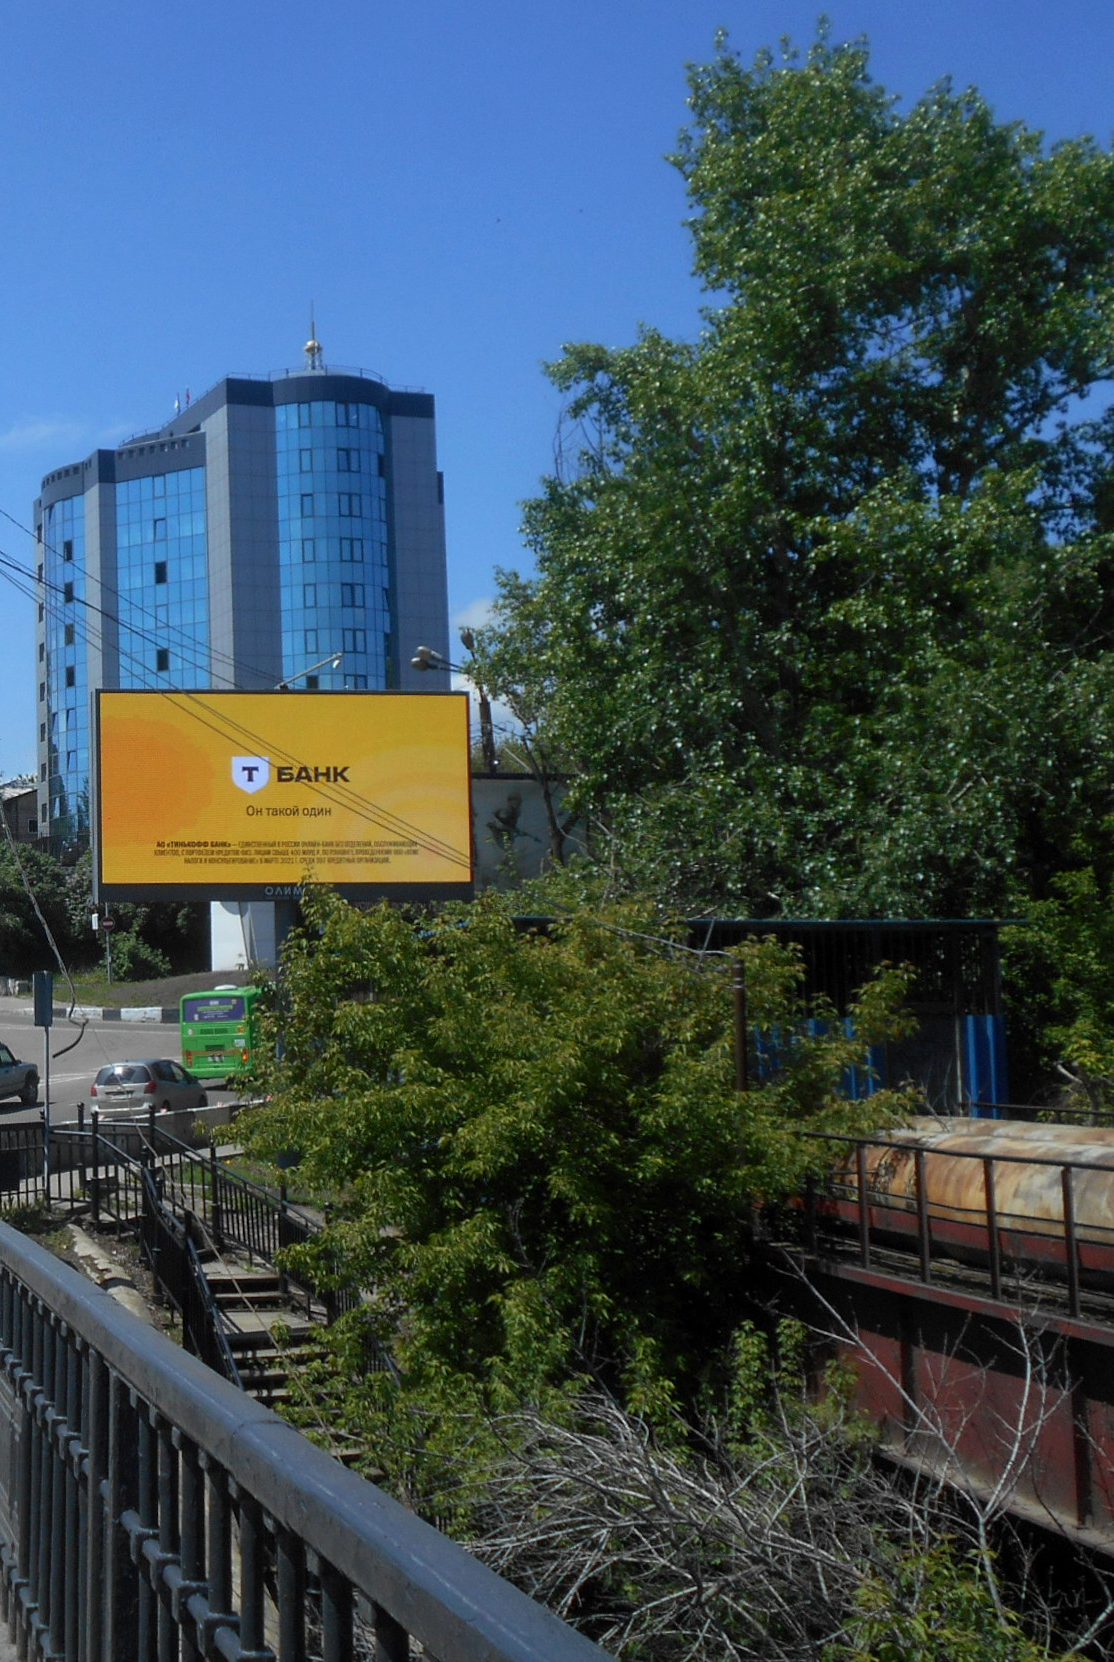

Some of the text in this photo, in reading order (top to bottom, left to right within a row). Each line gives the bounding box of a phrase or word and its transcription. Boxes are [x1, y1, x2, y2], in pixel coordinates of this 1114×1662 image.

[241, 766, 350, 783] Т БАНК
[246, 805, 332, 818] Он такой один
